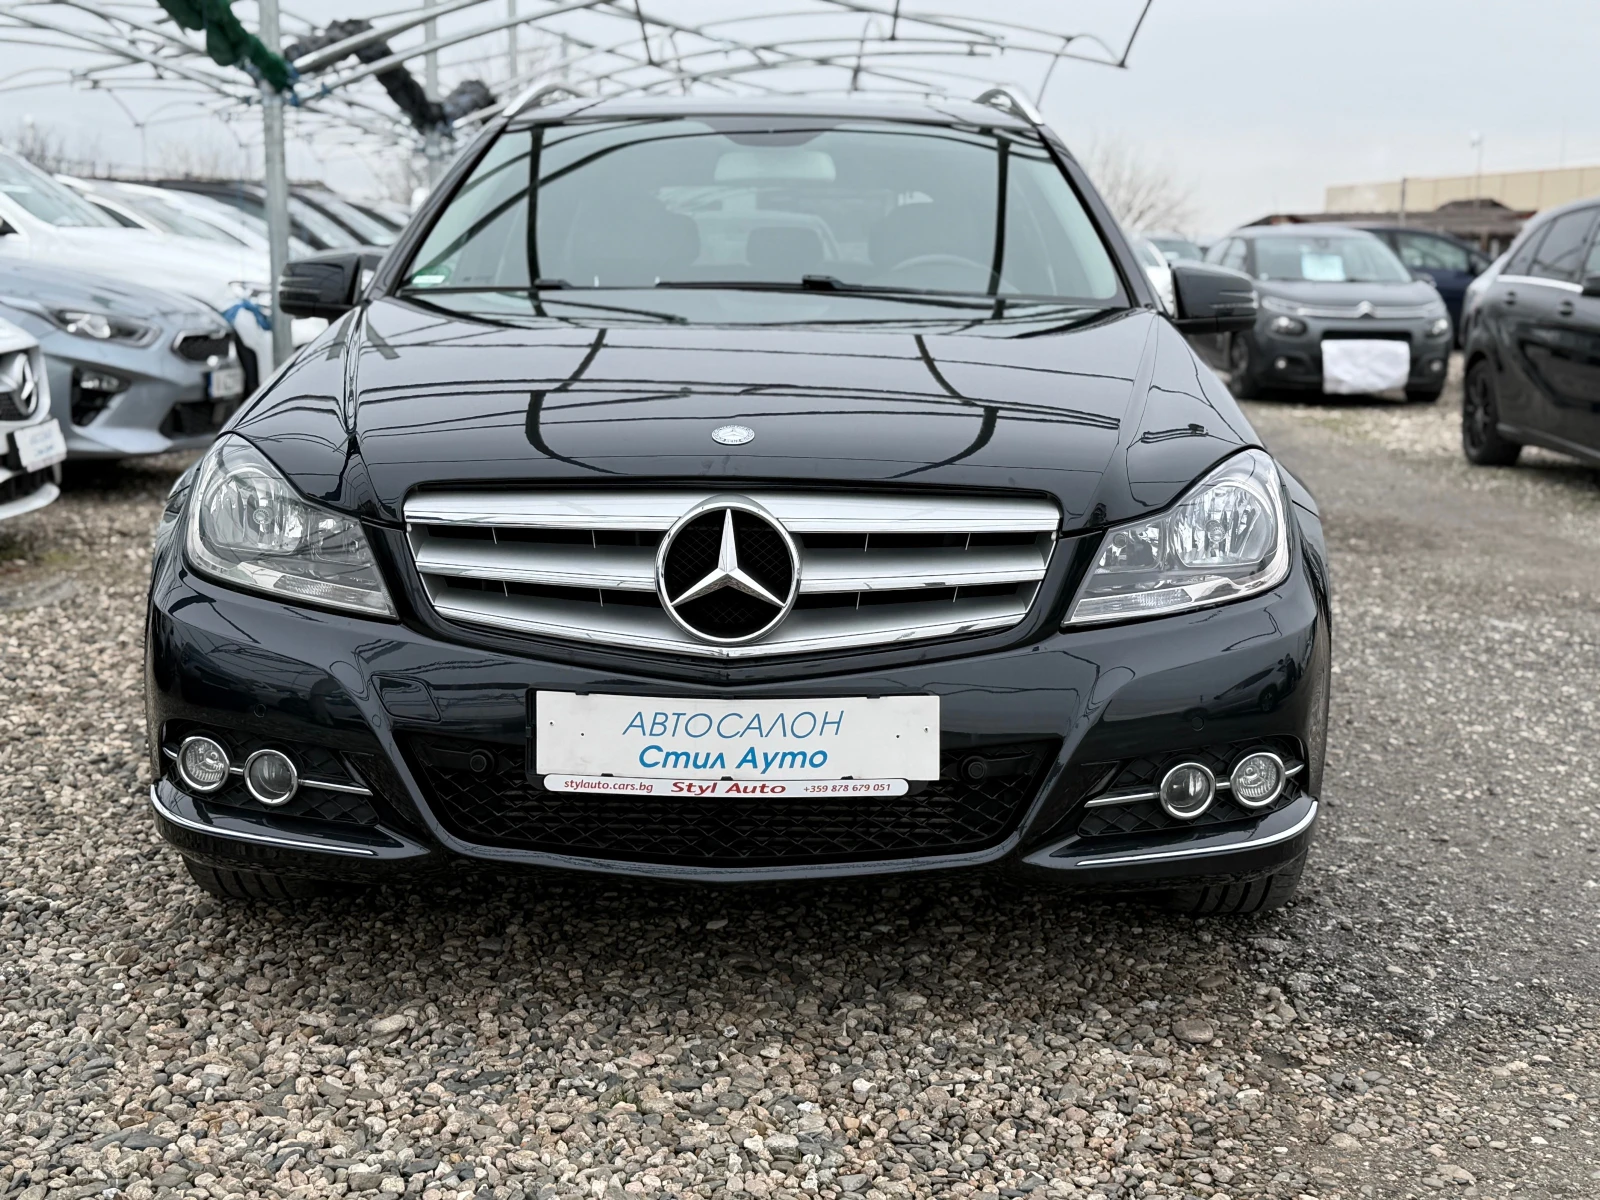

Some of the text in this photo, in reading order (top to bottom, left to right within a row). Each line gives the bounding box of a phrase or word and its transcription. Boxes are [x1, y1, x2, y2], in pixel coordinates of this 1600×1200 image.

[622, 710, 844, 739] АВТОСАЛОН
[638, 744, 828, 775] Стил Ауто
[564, 779, 654, 793] stylauto.cars.bg
[670, 781, 786, 796] Styl Auto
[803, 783, 891, 793] +359 878 679 051
